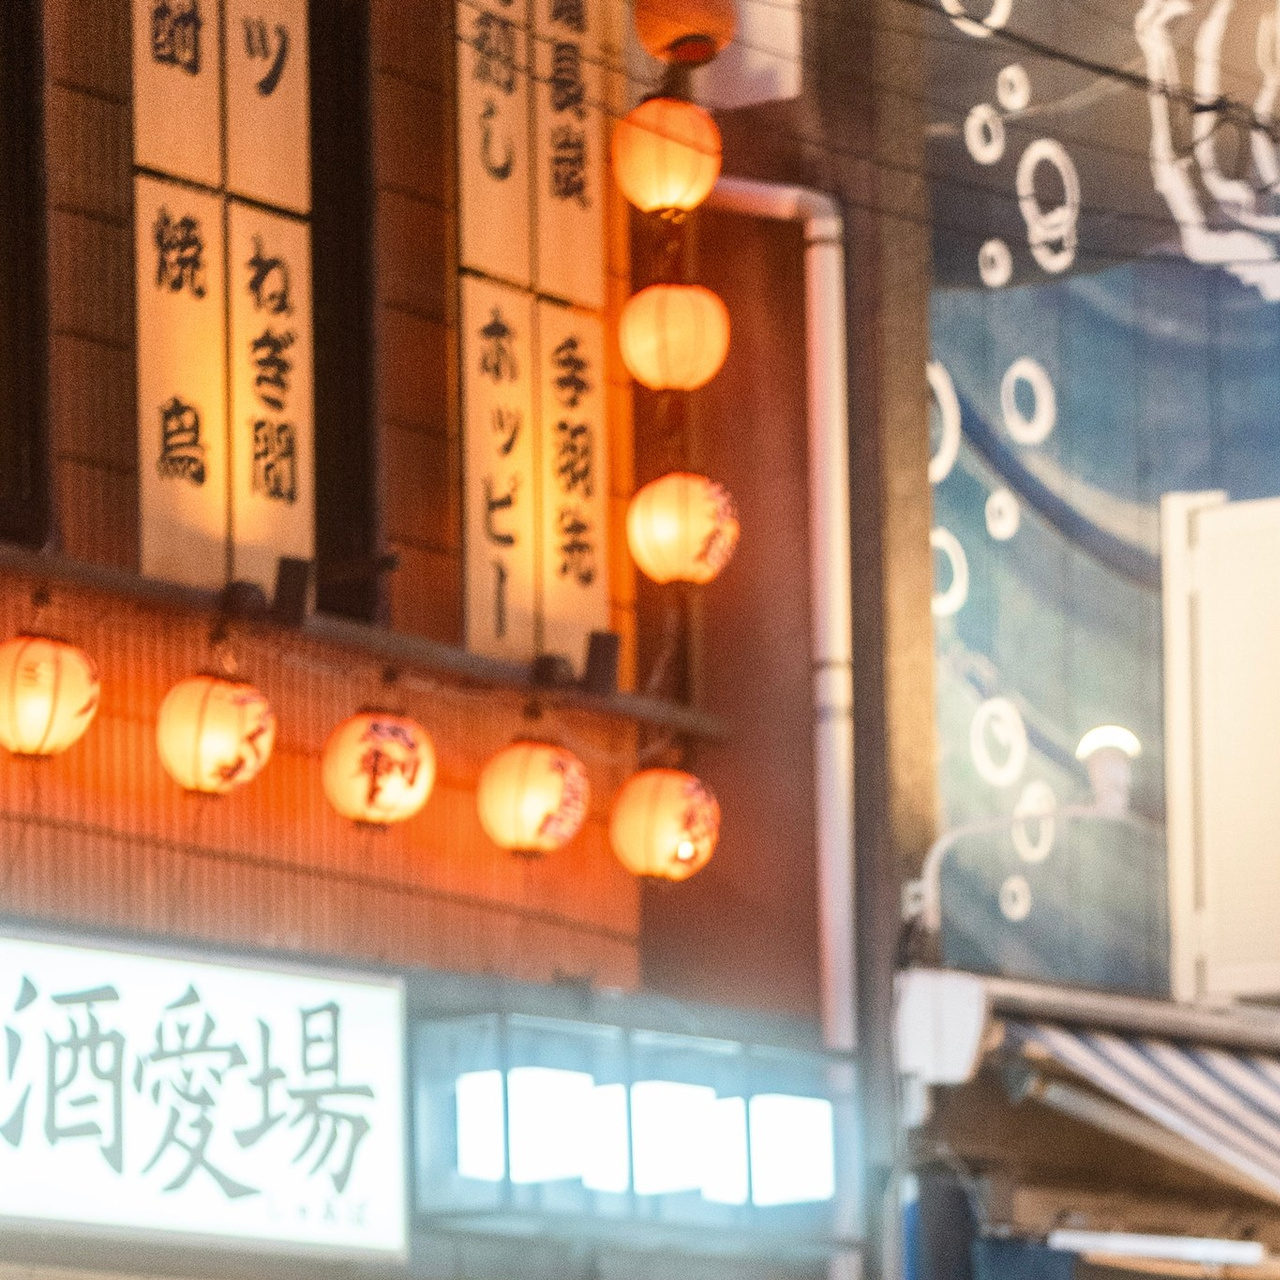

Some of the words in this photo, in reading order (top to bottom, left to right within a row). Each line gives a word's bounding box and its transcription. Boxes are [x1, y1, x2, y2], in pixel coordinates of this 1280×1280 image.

[154, 204, 207, 487] 焼鳥
[0, 973, 376, 1200] 酒愛場
